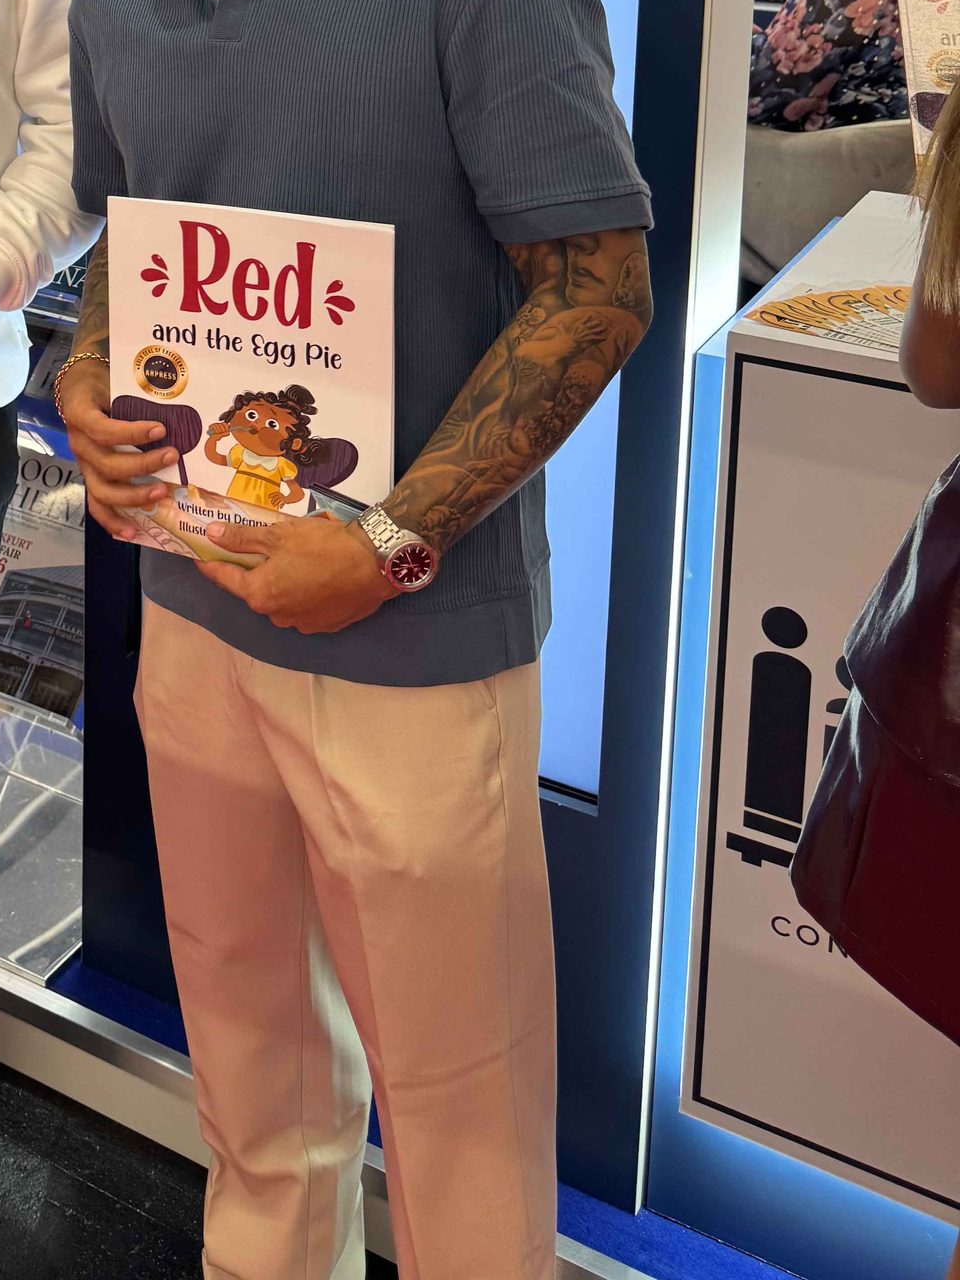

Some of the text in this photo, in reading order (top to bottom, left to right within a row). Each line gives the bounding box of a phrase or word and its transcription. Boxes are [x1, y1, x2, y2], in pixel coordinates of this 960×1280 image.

[178, 220, 317, 330] Red
[152, 323, 343, 371] and the Egg Pie
[20, 459, 84, 488] OOK
[177, 500, 231, 524] Written by
